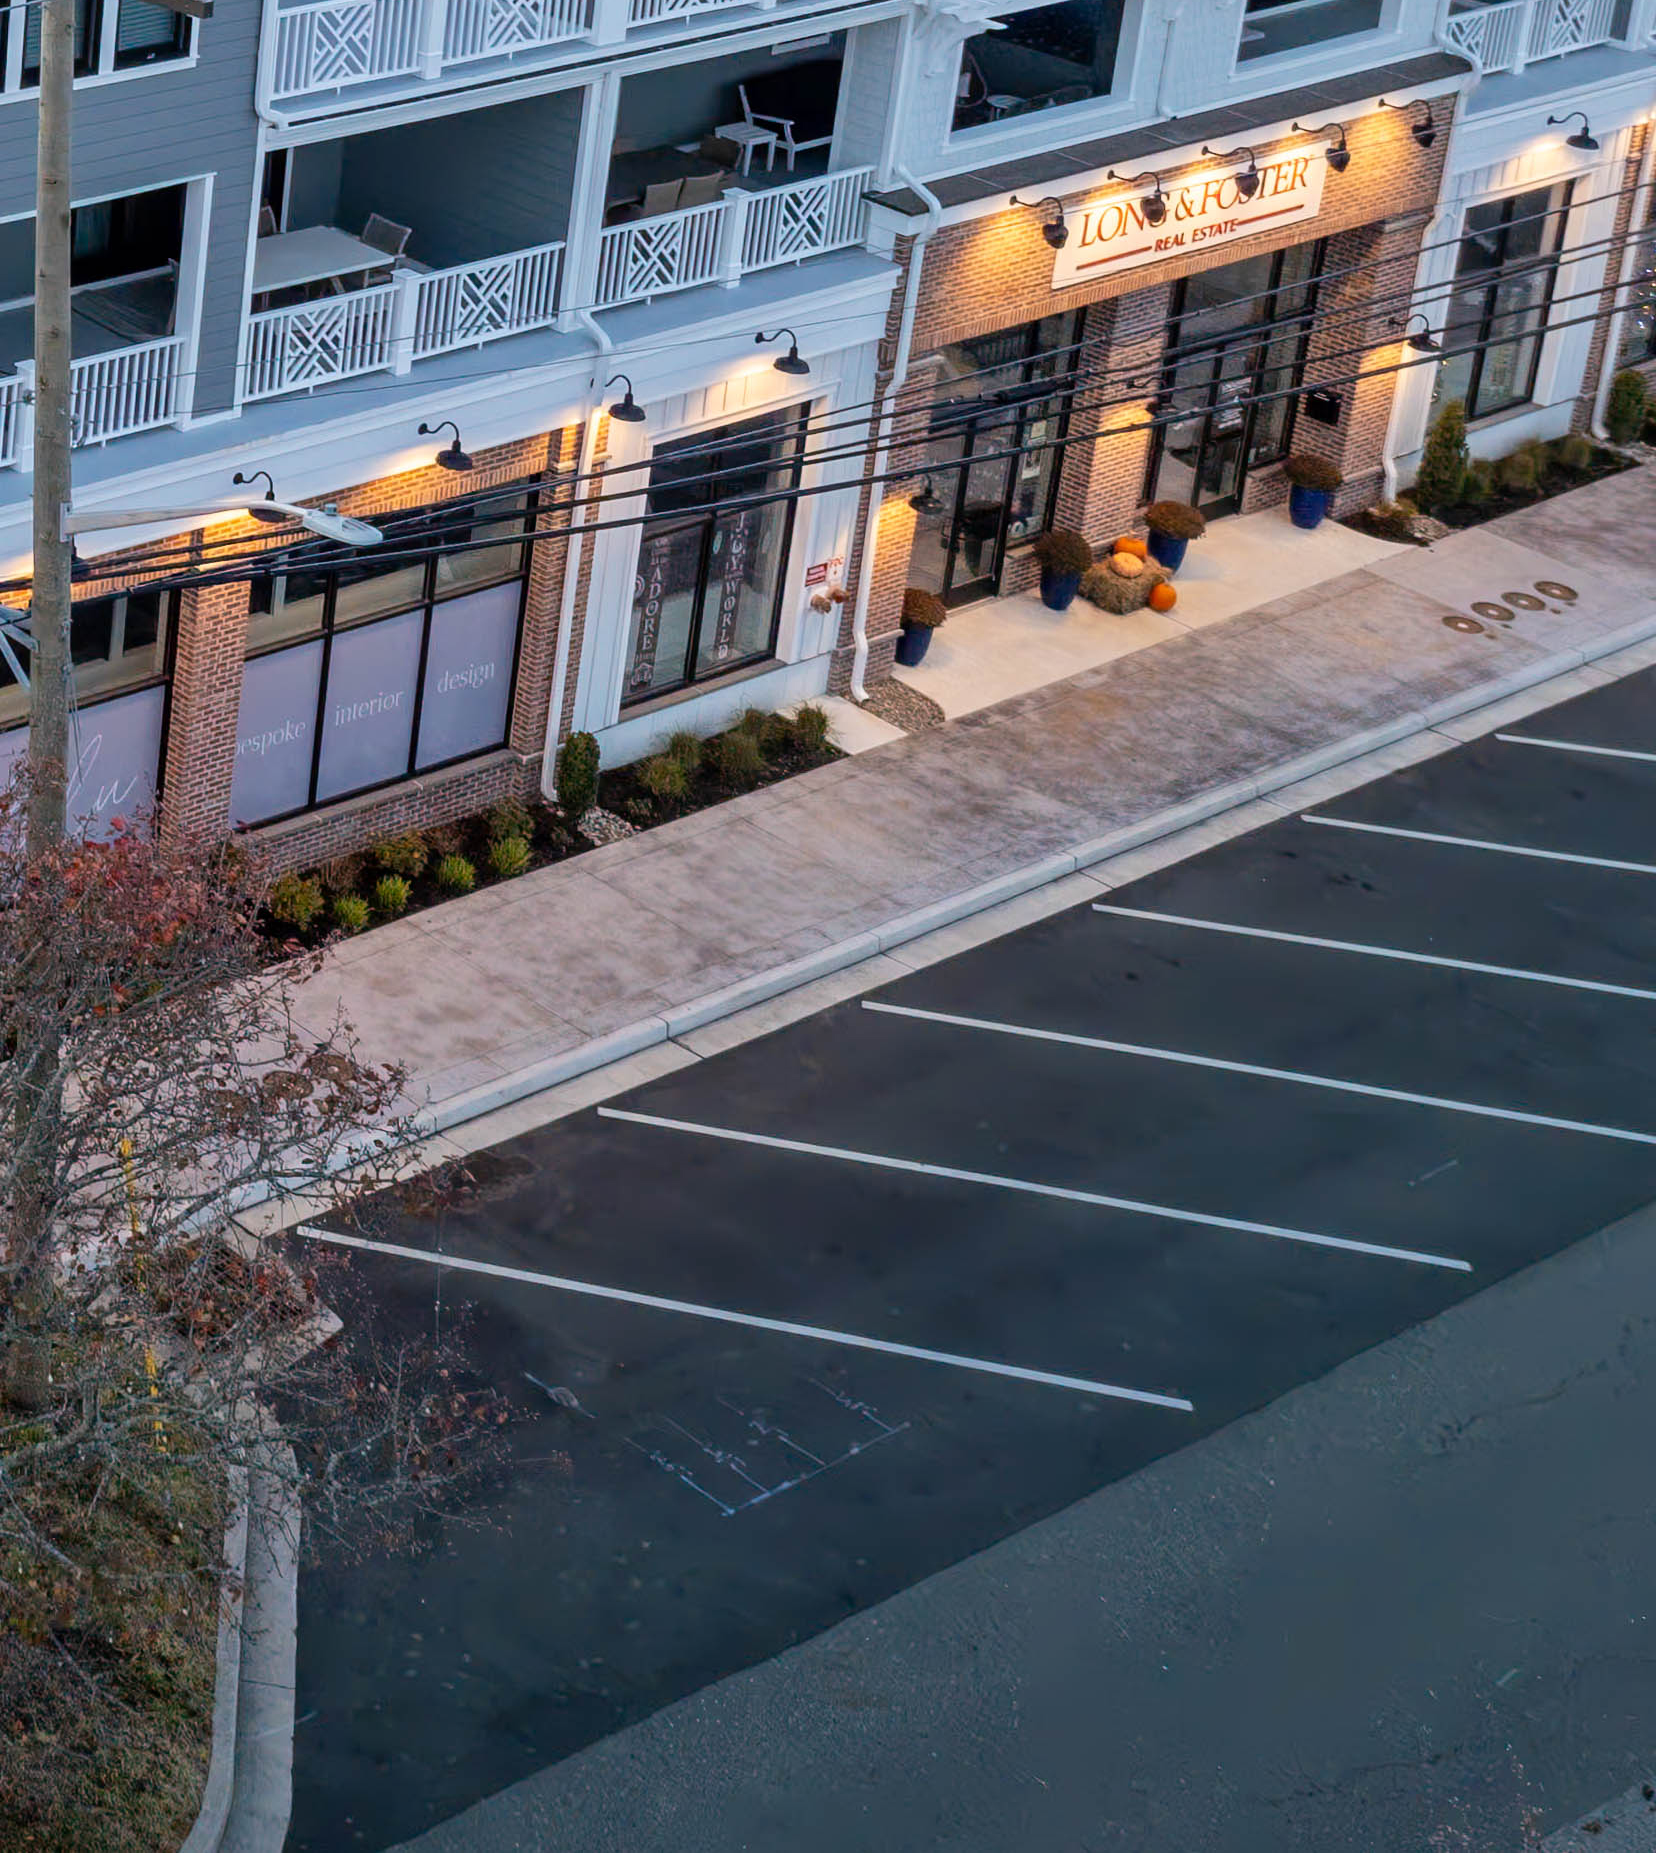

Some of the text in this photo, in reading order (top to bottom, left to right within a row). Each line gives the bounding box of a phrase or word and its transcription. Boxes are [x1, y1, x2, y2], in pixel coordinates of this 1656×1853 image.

[1175, 187, 1194, 220] &
[1154, 218, 1239, 252] REAL ESTATE
[335, 691, 405, 727] interior
[437, 661, 495, 694] design
